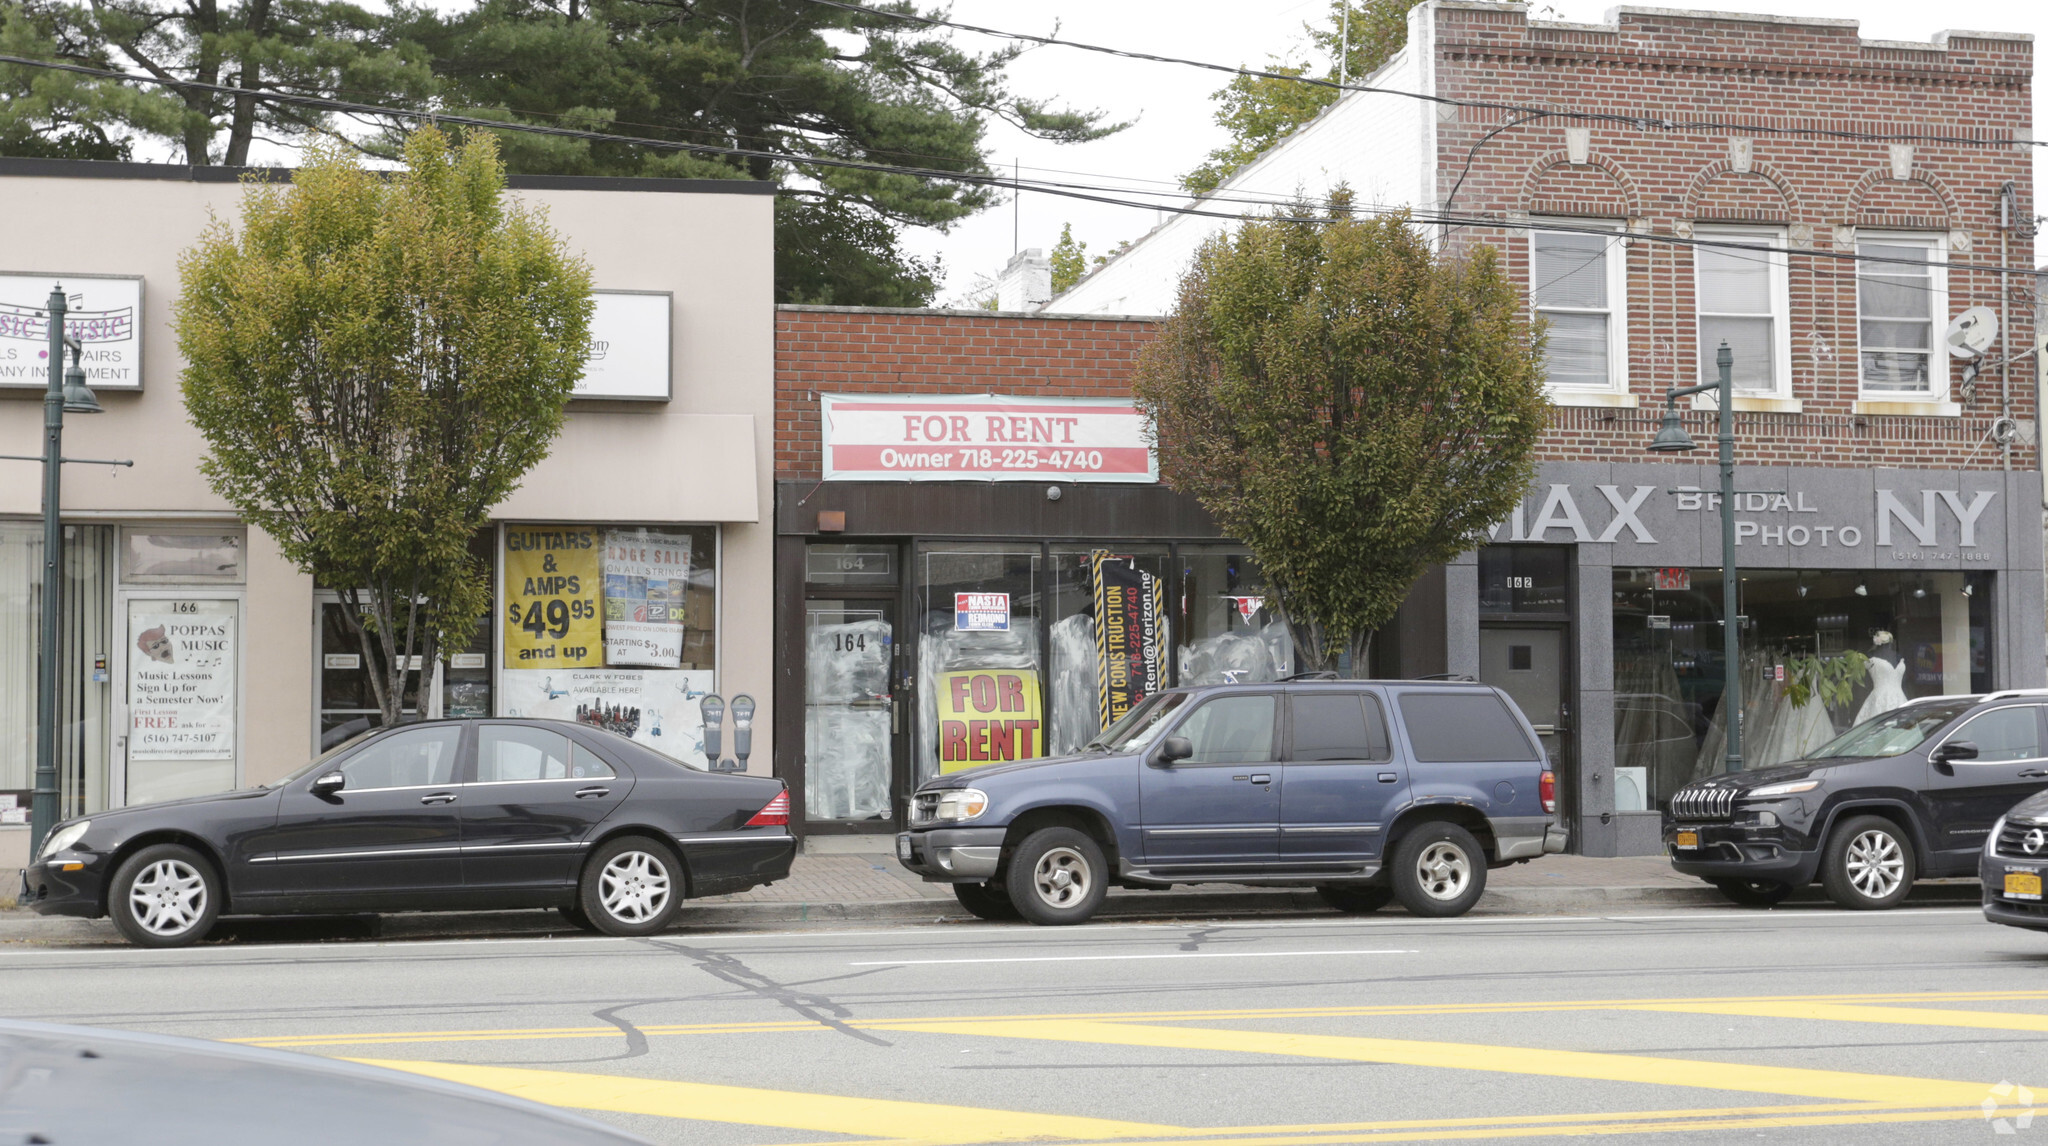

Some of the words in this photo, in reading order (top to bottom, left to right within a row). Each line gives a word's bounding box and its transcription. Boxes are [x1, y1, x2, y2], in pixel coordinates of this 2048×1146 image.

[45, 311, 124, 341] usic
[64, 349, 122, 363] EAIRS
[31, 366, 131, 380] INMENT
[903, 415, 971, 442] FOR
[985, 417, 1078, 444] RENT
[880, 448, 953, 468] Owner
[960, 449, 1103, 470] 718-225-4740
[1876, 489, 1998, 547] NY
[506, 531, 593, 552] GUITARS
[1733, 521, 1862, 547] PHOTO
[542, 553, 558, 573] &
[654, 549, 689, 565] SALE
[835, 557, 865, 570] 164
[606, 564, 620, 573] ON
[624, 566, 641, 575] ALL
[645, 567, 689, 577] STRINGS
[523, 576, 581, 596] AMPS
[1507, 577, 1533, 588] 162
[172, 602, 197, 613] 166
[968, 595, 1006, 606] NASTA
[170, 625, 225, 636] POPPAS
[1107, 585, 1127, 688] CONSTRUCTION
[1127, 587, 1142, 677] 718-225-4740
[1140, 569, 1158, 697] Rent@Verizon.ne
[181, 640, 229, 651] MUSIC
[605, 638, 643, 647] STARTING
[834, 634, 866, 651] 164
[519, 645, 556, 660] and
[563, 647, 588, 661] up
[137, 671, 169, 681] Music
[172, 671, 213, 680] Lessons
[137, 683, 160, 694] Sign
[163, 683, 179, 694] Up
[182, 683, 198, 692] for
[573, 686, 616, 694] AVAILABLE
[618, 687, 643, 695] HERE!
[949, 674, 1025, 713] FOR
[146, 695, 194, 704] Semester
[197, 694, 224, 704] Now!
[1111, 689, 1129, 722] NEW
[134, 716, 178, 729] FREE
[143, 734, 169, 744] (516)
[172, 734, 217, 743] 747-5107
[942, 720, 1040, 762] RENT
